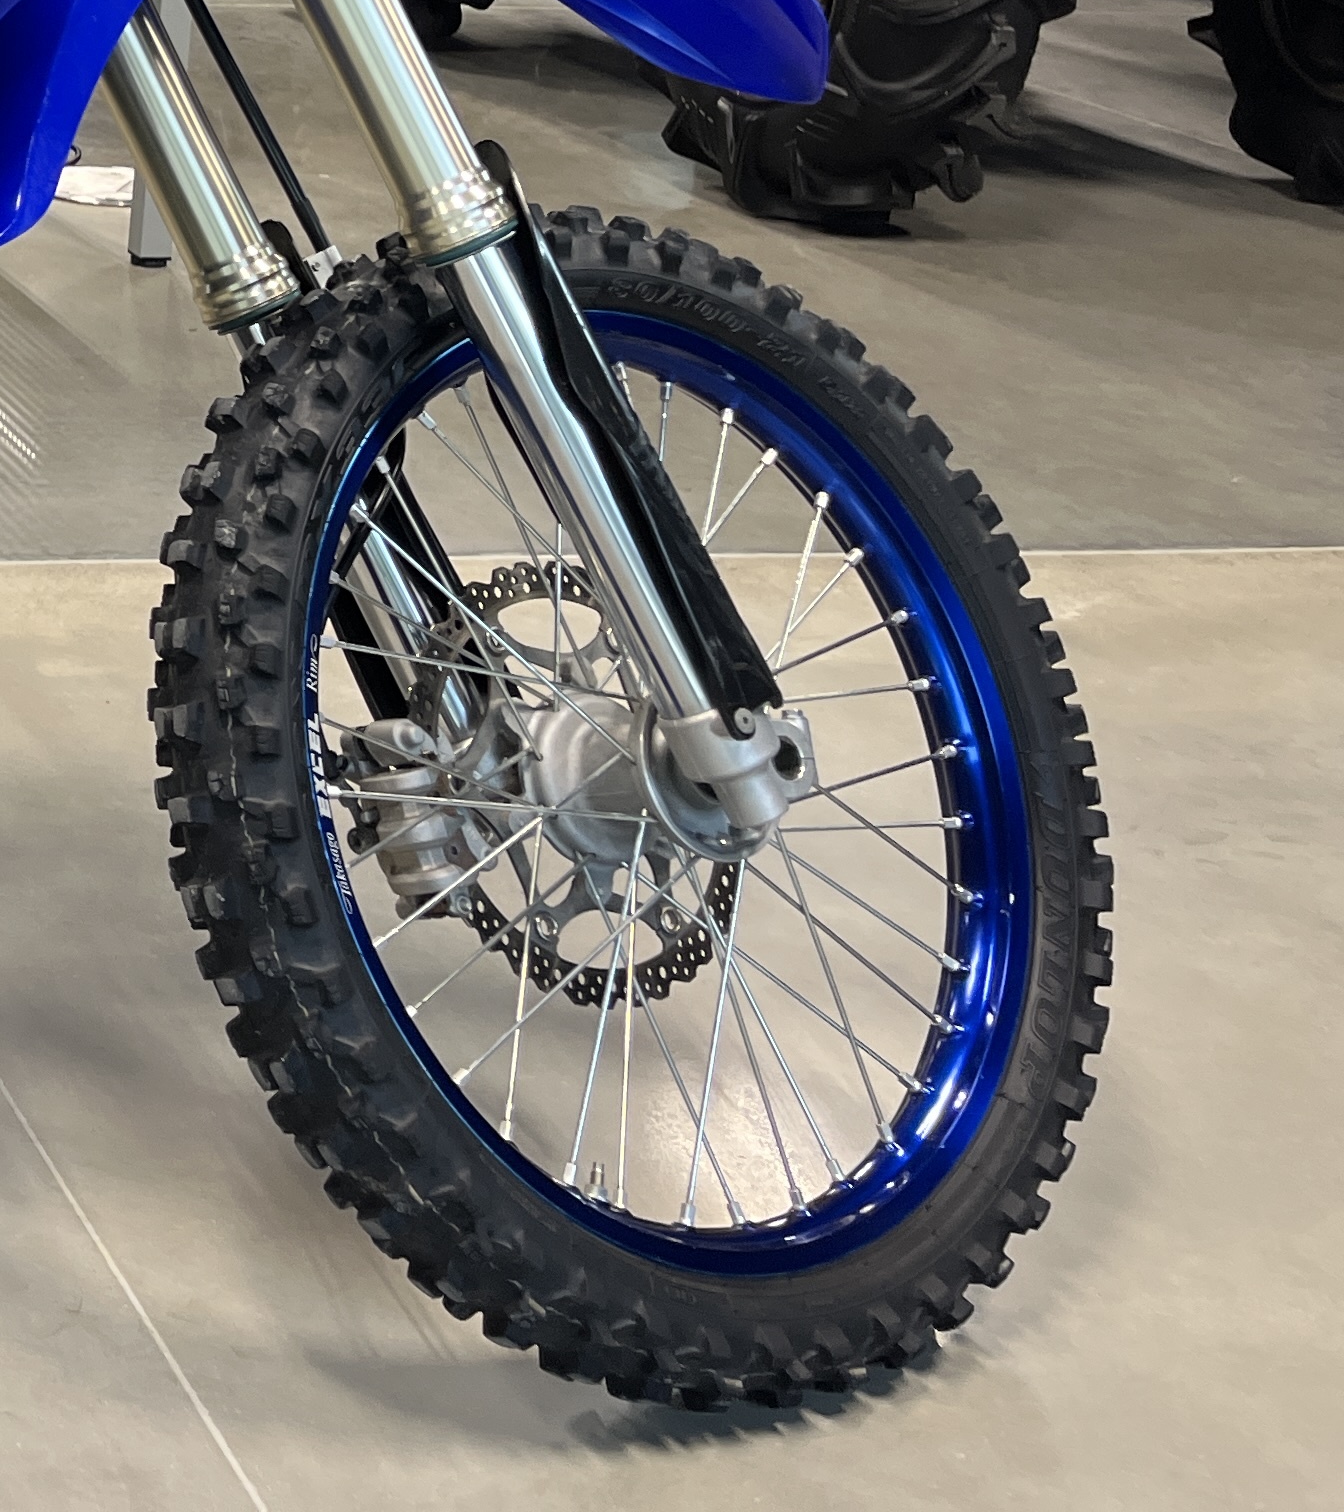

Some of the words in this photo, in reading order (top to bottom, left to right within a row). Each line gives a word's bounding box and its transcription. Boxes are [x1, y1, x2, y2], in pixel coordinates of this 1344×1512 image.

[306, 638, 318, 693] Rim
[308, 712, 332, 819] EXCEL
[1018, 790, 1072, 1102] DUNLOP
